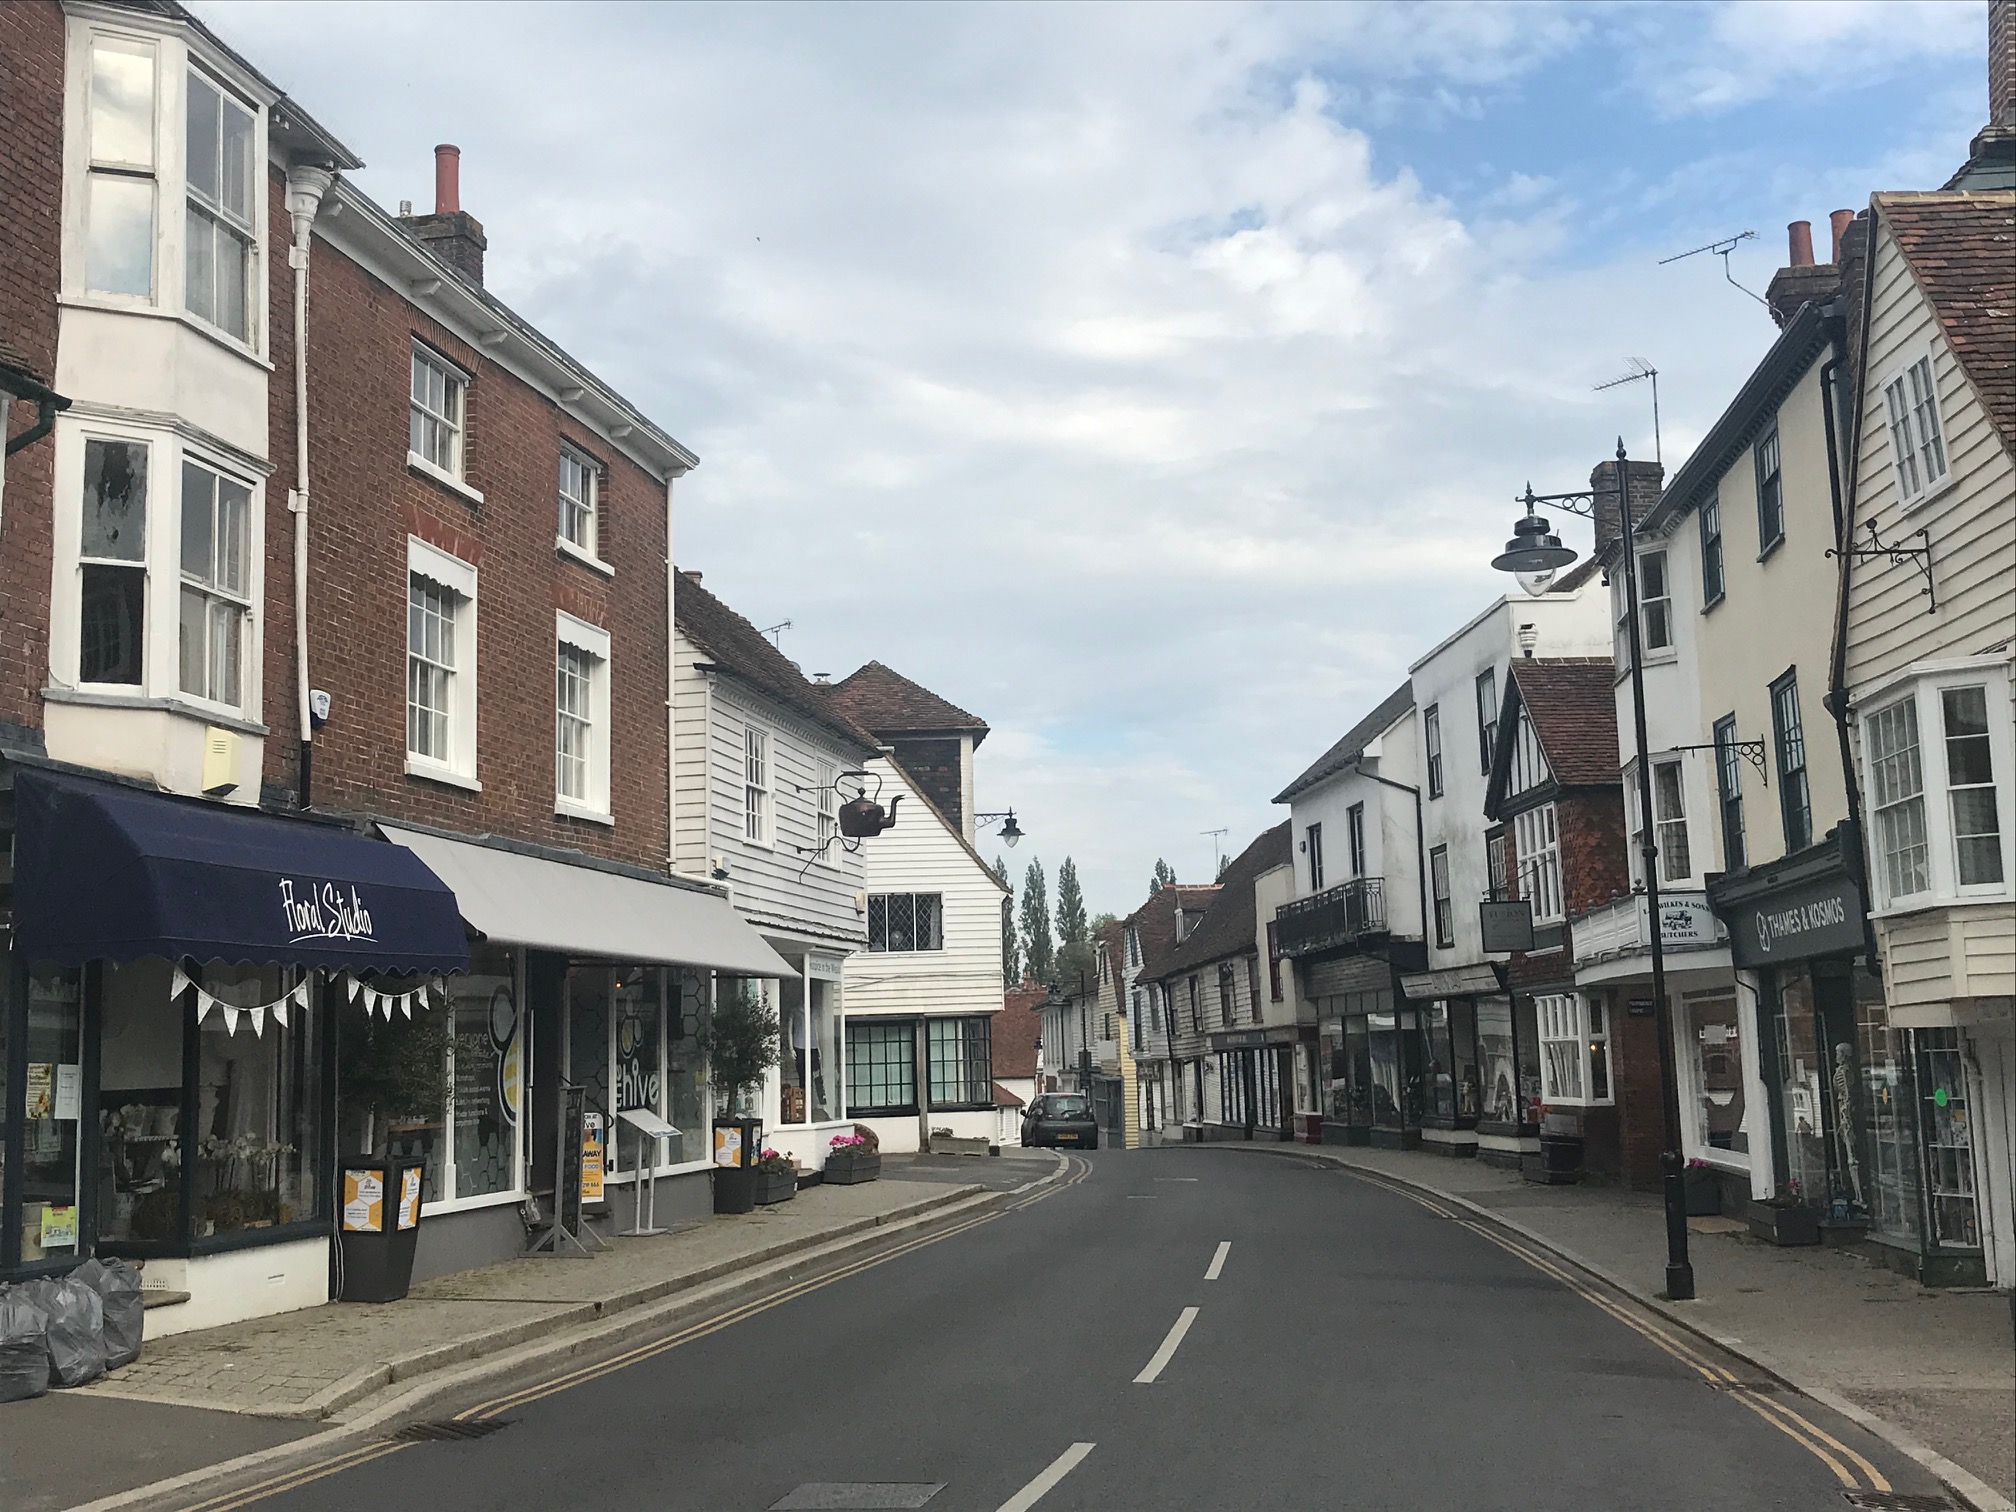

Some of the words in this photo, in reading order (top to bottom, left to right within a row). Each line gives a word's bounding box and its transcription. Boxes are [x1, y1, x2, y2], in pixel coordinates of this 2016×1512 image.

[279, 877, 326, 934] Floral
[322, 881, 373, 942] Studio
[1691, 902, 1710, 912] SONS
[1767, 908, 1802, 939] THAMES
[1800, 906, 1810, 931] &
[1807, 896, 1845, 929] KOSMOS
[622, 1057, 660, 1106] hive
[582, 1149, 602, 1158] AWAY
